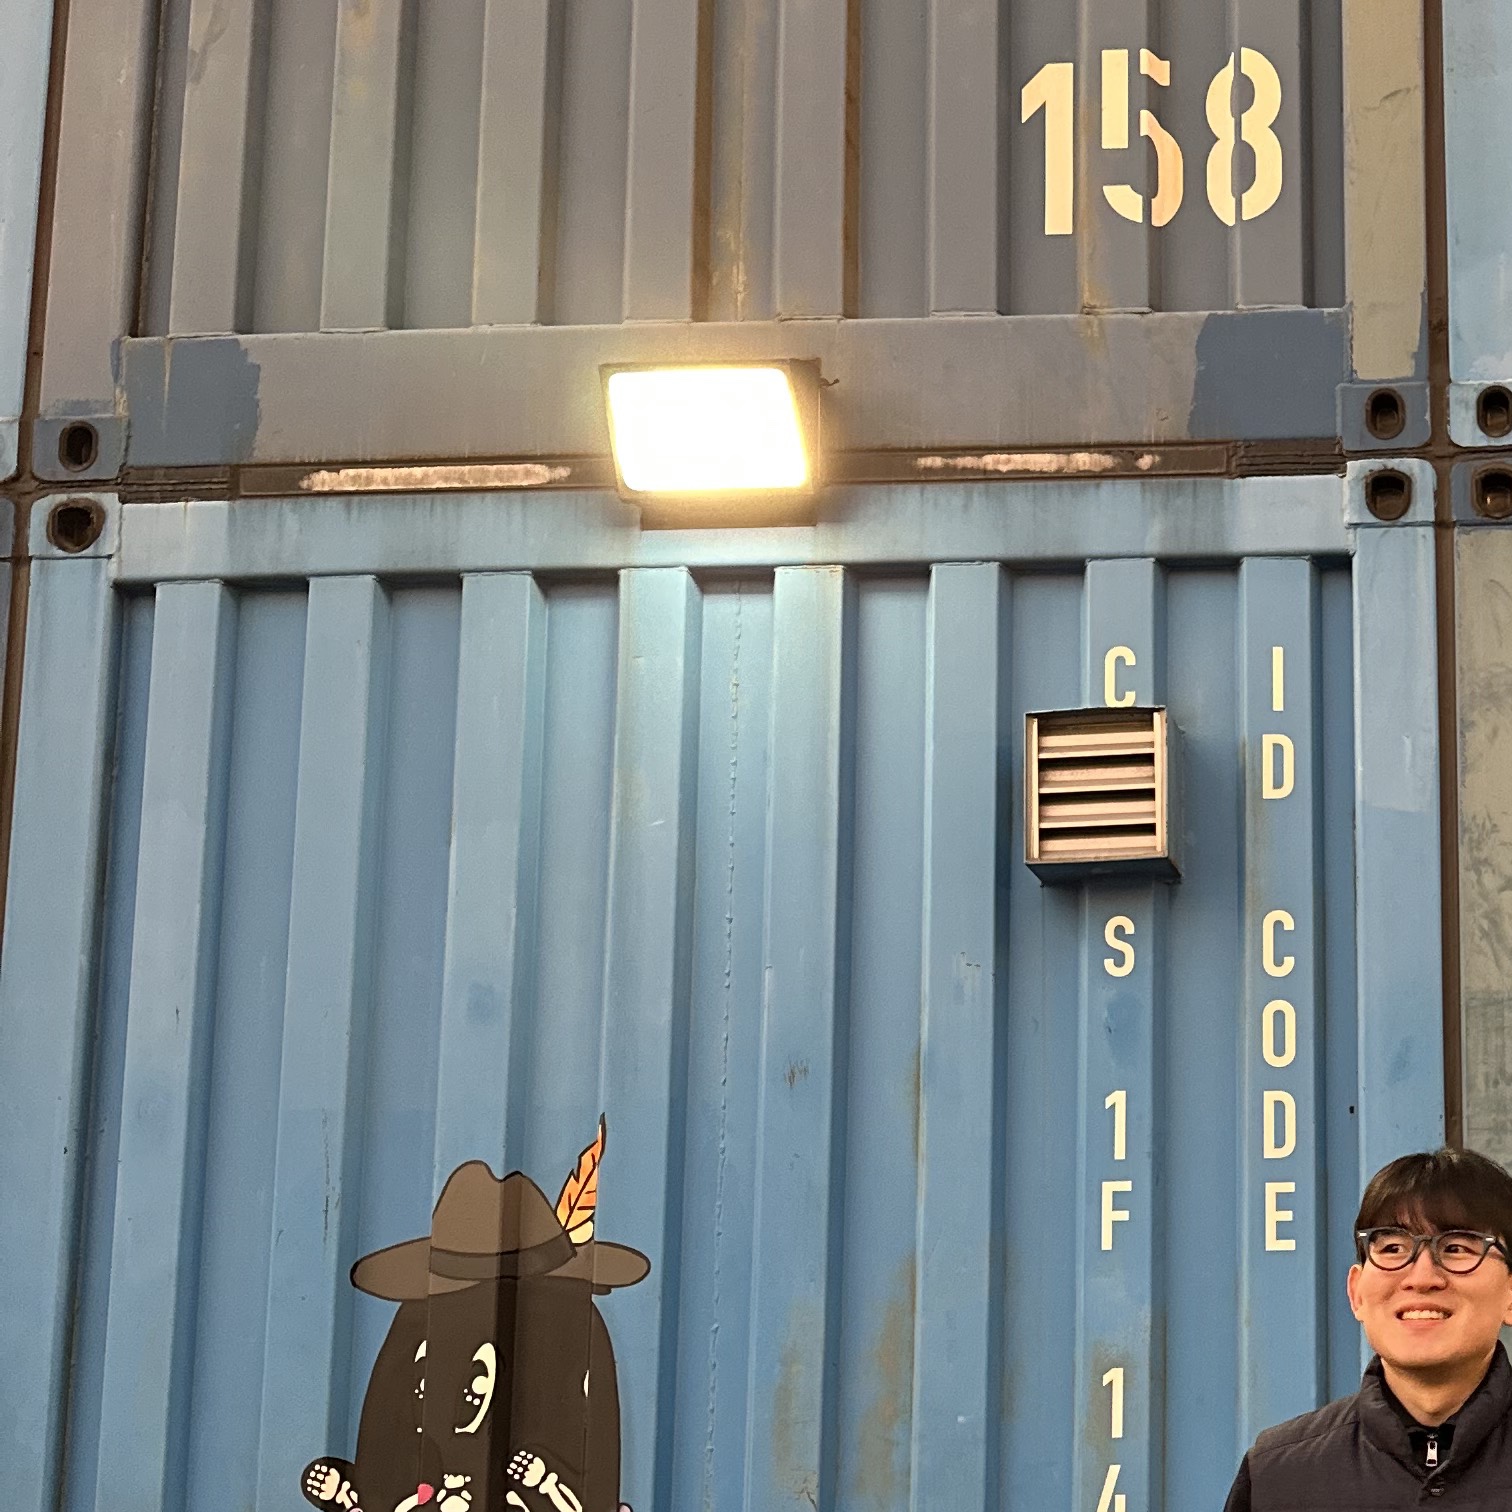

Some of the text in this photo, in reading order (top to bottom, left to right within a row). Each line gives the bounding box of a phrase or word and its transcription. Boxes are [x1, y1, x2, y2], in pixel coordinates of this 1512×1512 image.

[1021, 46, 1284, 236] 158
[1262, 646, 1297, 1252] ID CODE
[1101, 1090, 1134, 1251] 1F
